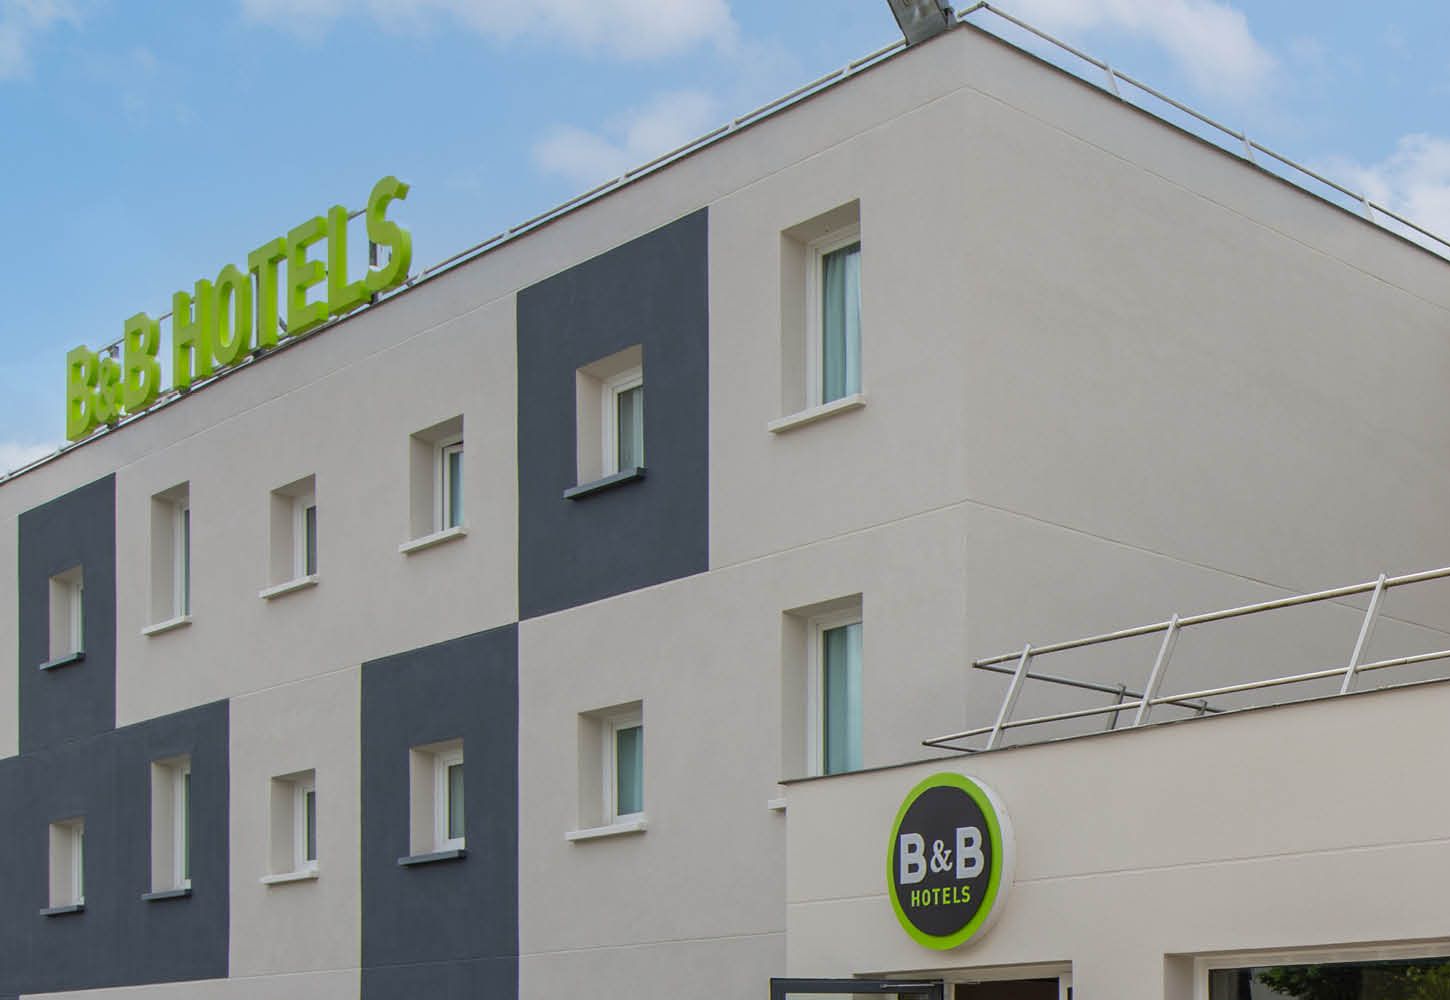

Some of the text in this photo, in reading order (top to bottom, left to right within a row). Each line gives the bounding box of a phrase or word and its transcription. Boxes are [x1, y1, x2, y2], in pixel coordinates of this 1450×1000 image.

[66, 175, 412, 441] B&B HOTELS
[899, 826, 984, 885] B&B
[911, 885, 971, 907] HOTELS
